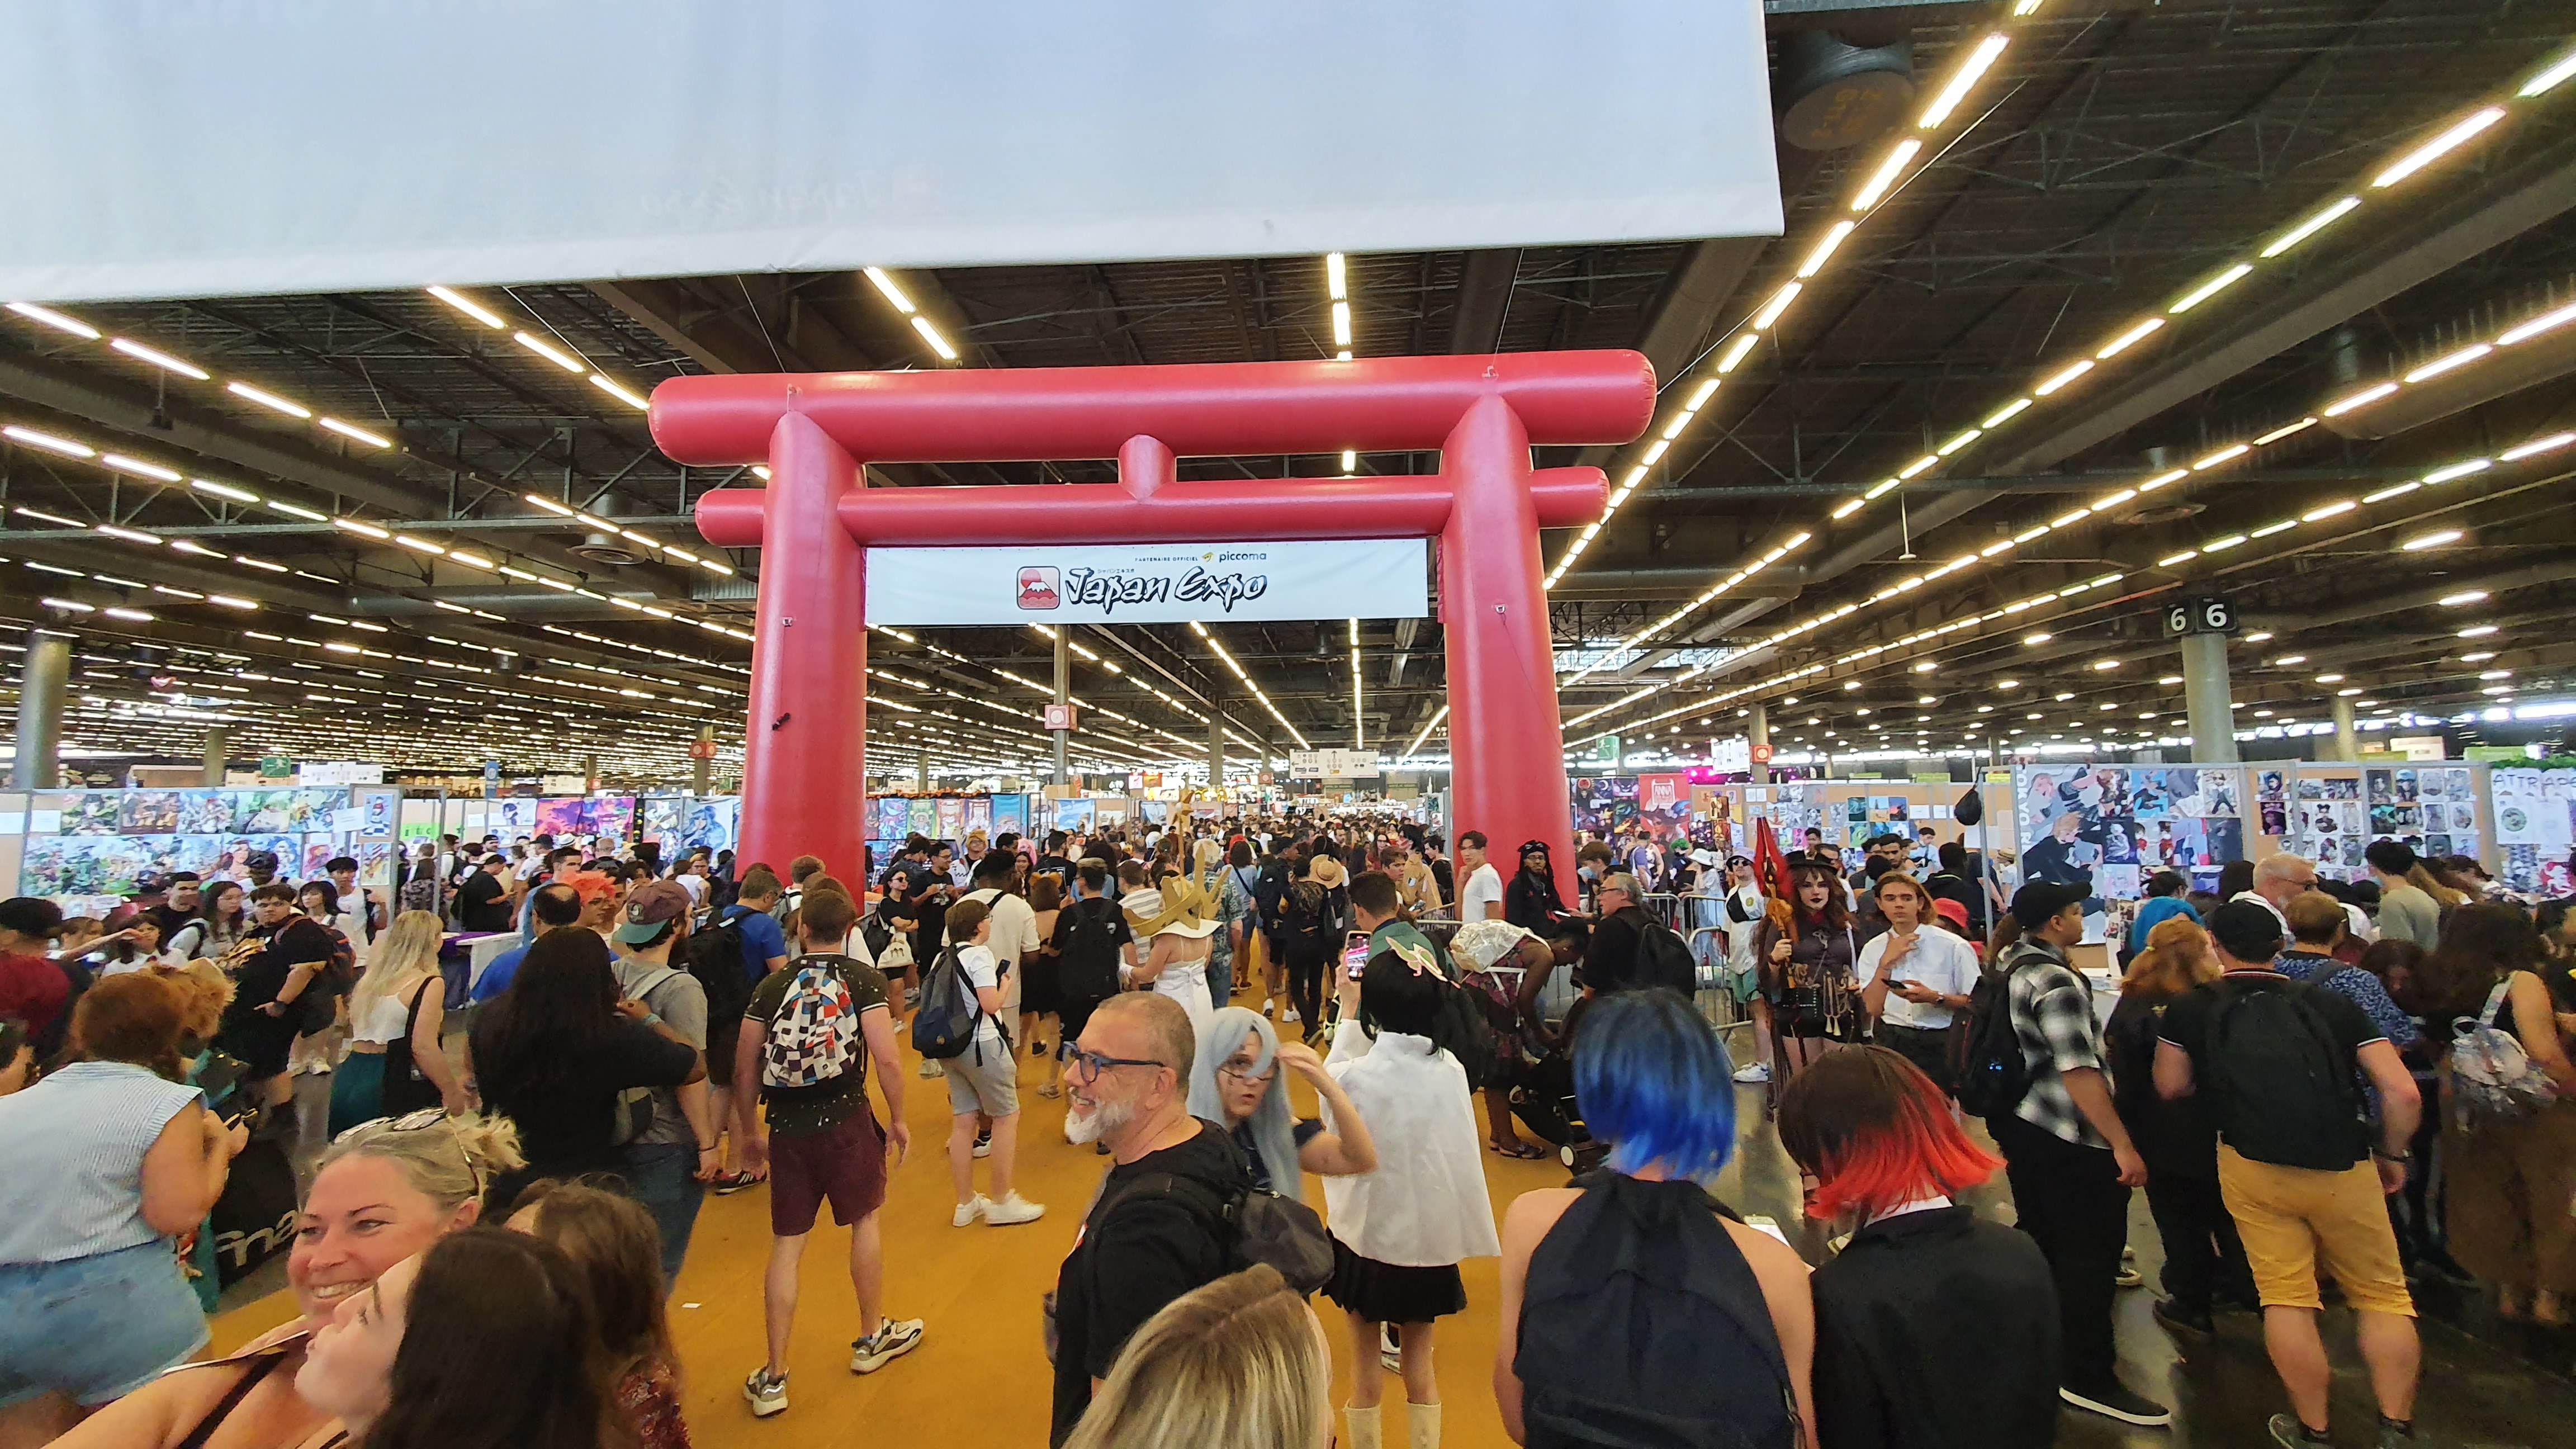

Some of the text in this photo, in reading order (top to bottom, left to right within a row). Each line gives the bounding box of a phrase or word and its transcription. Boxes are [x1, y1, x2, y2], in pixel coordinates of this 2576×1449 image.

[1219, 551, 1267, 562] piccoma
[1066, 566, 1268, 614] Japan Expo
[2171, 608, 2186, 631] 6
[2206, 603, 2227, 627] 6
